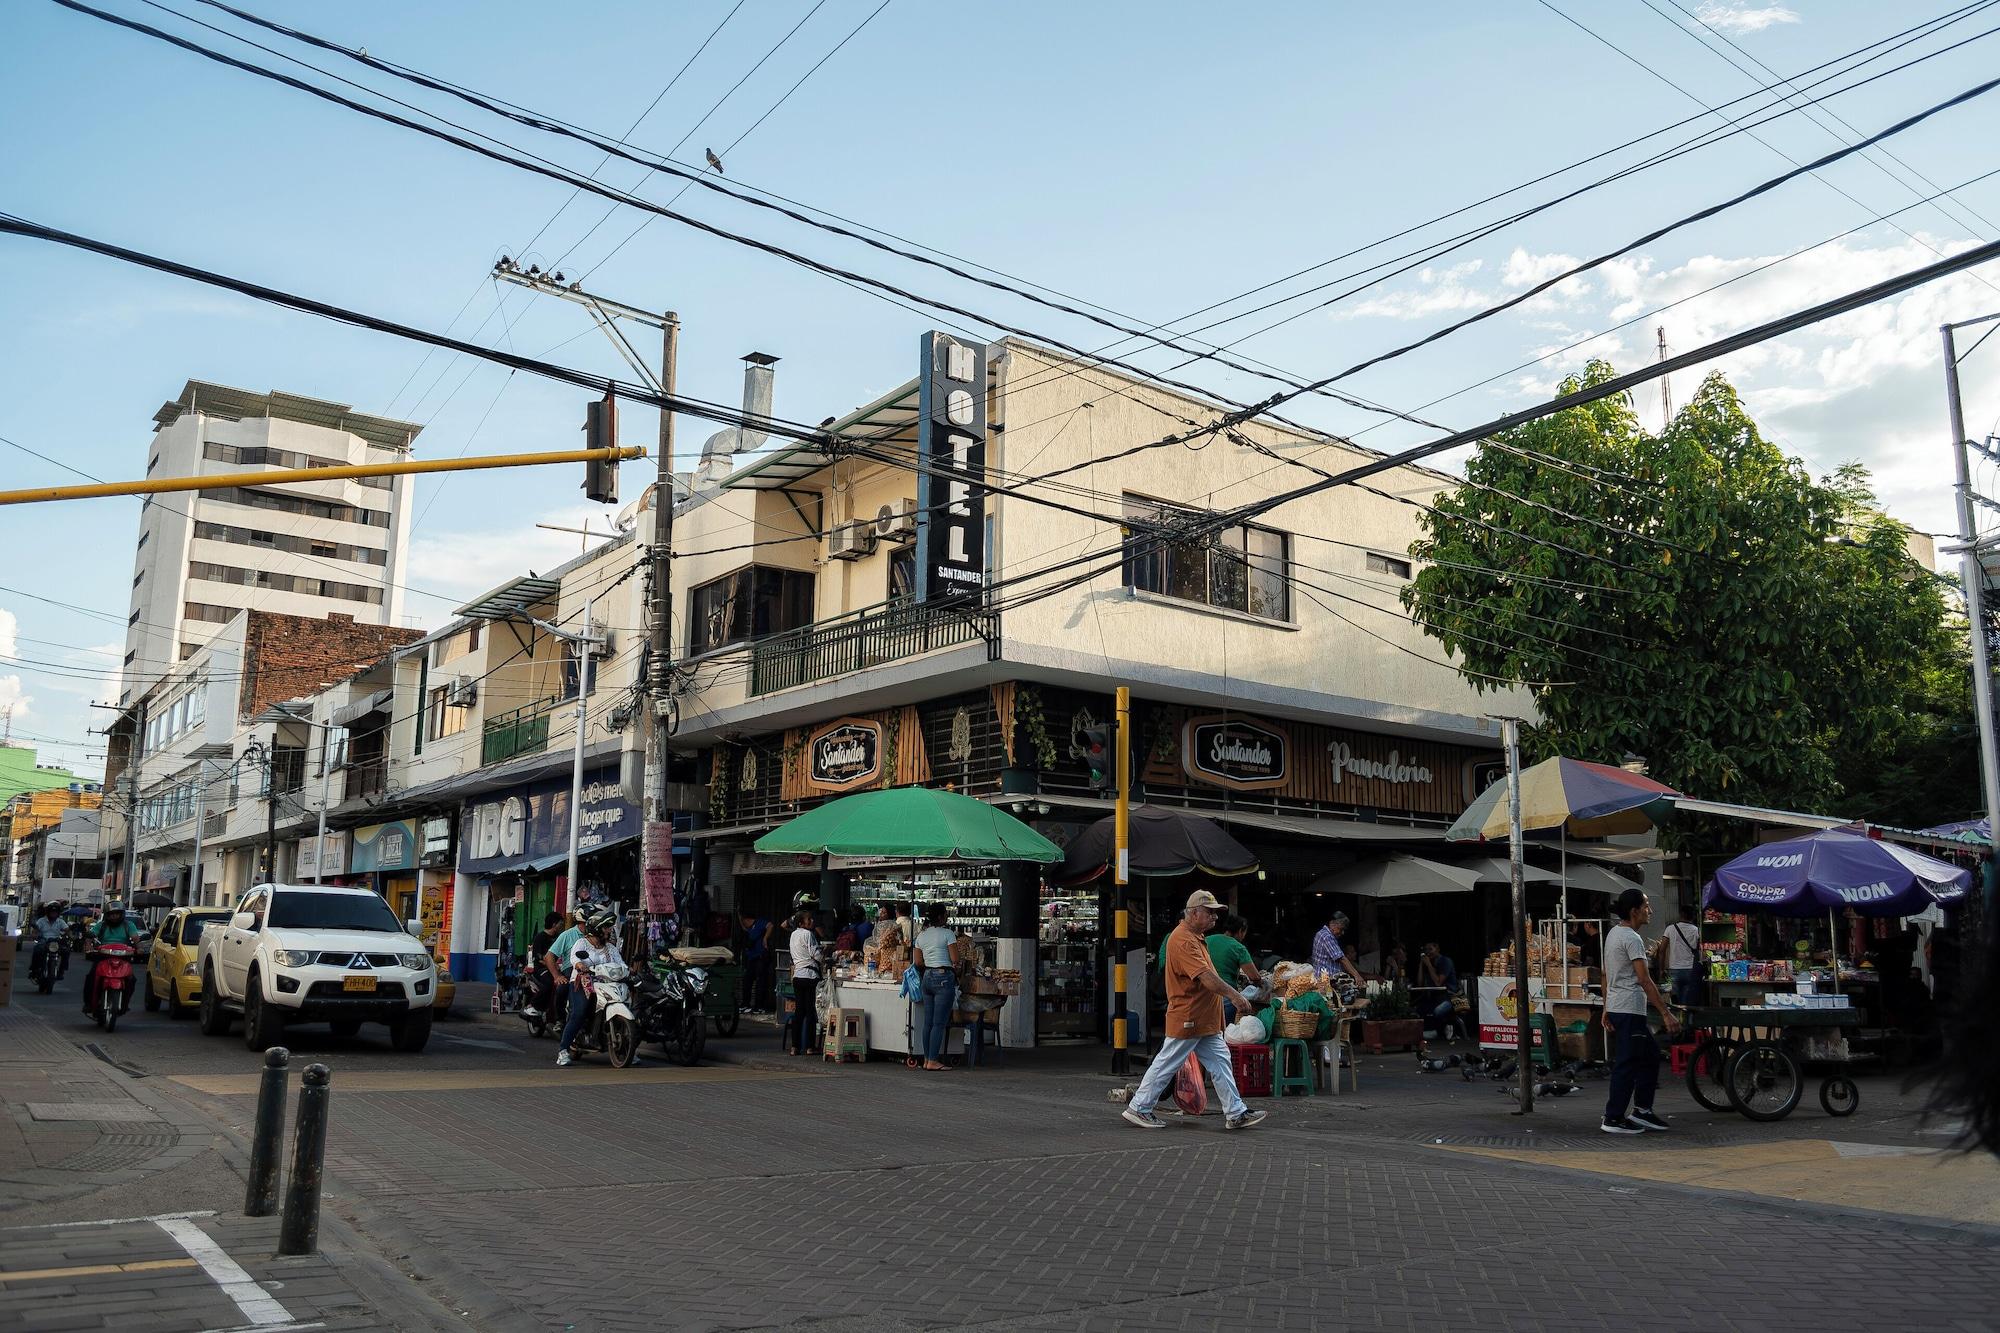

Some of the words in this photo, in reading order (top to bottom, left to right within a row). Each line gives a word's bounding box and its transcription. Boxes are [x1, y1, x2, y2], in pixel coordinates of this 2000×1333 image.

[948, 344, 975, 562] HOTEL
[938, 566, 982, 584] SANTANDER
[821, 740, 866, 769] Santander
[1210, 732, 1272, 765] Santander
[470, 796, 527, 860] IBG
[605, 807, 624, 828] que
[1757, 854, 1803, 868] WOM
[1737, 890, 1747, 898] TU
[1738, 882, 1786, 896] COMPRA
[1838, 881, 1893, 903] WOM
